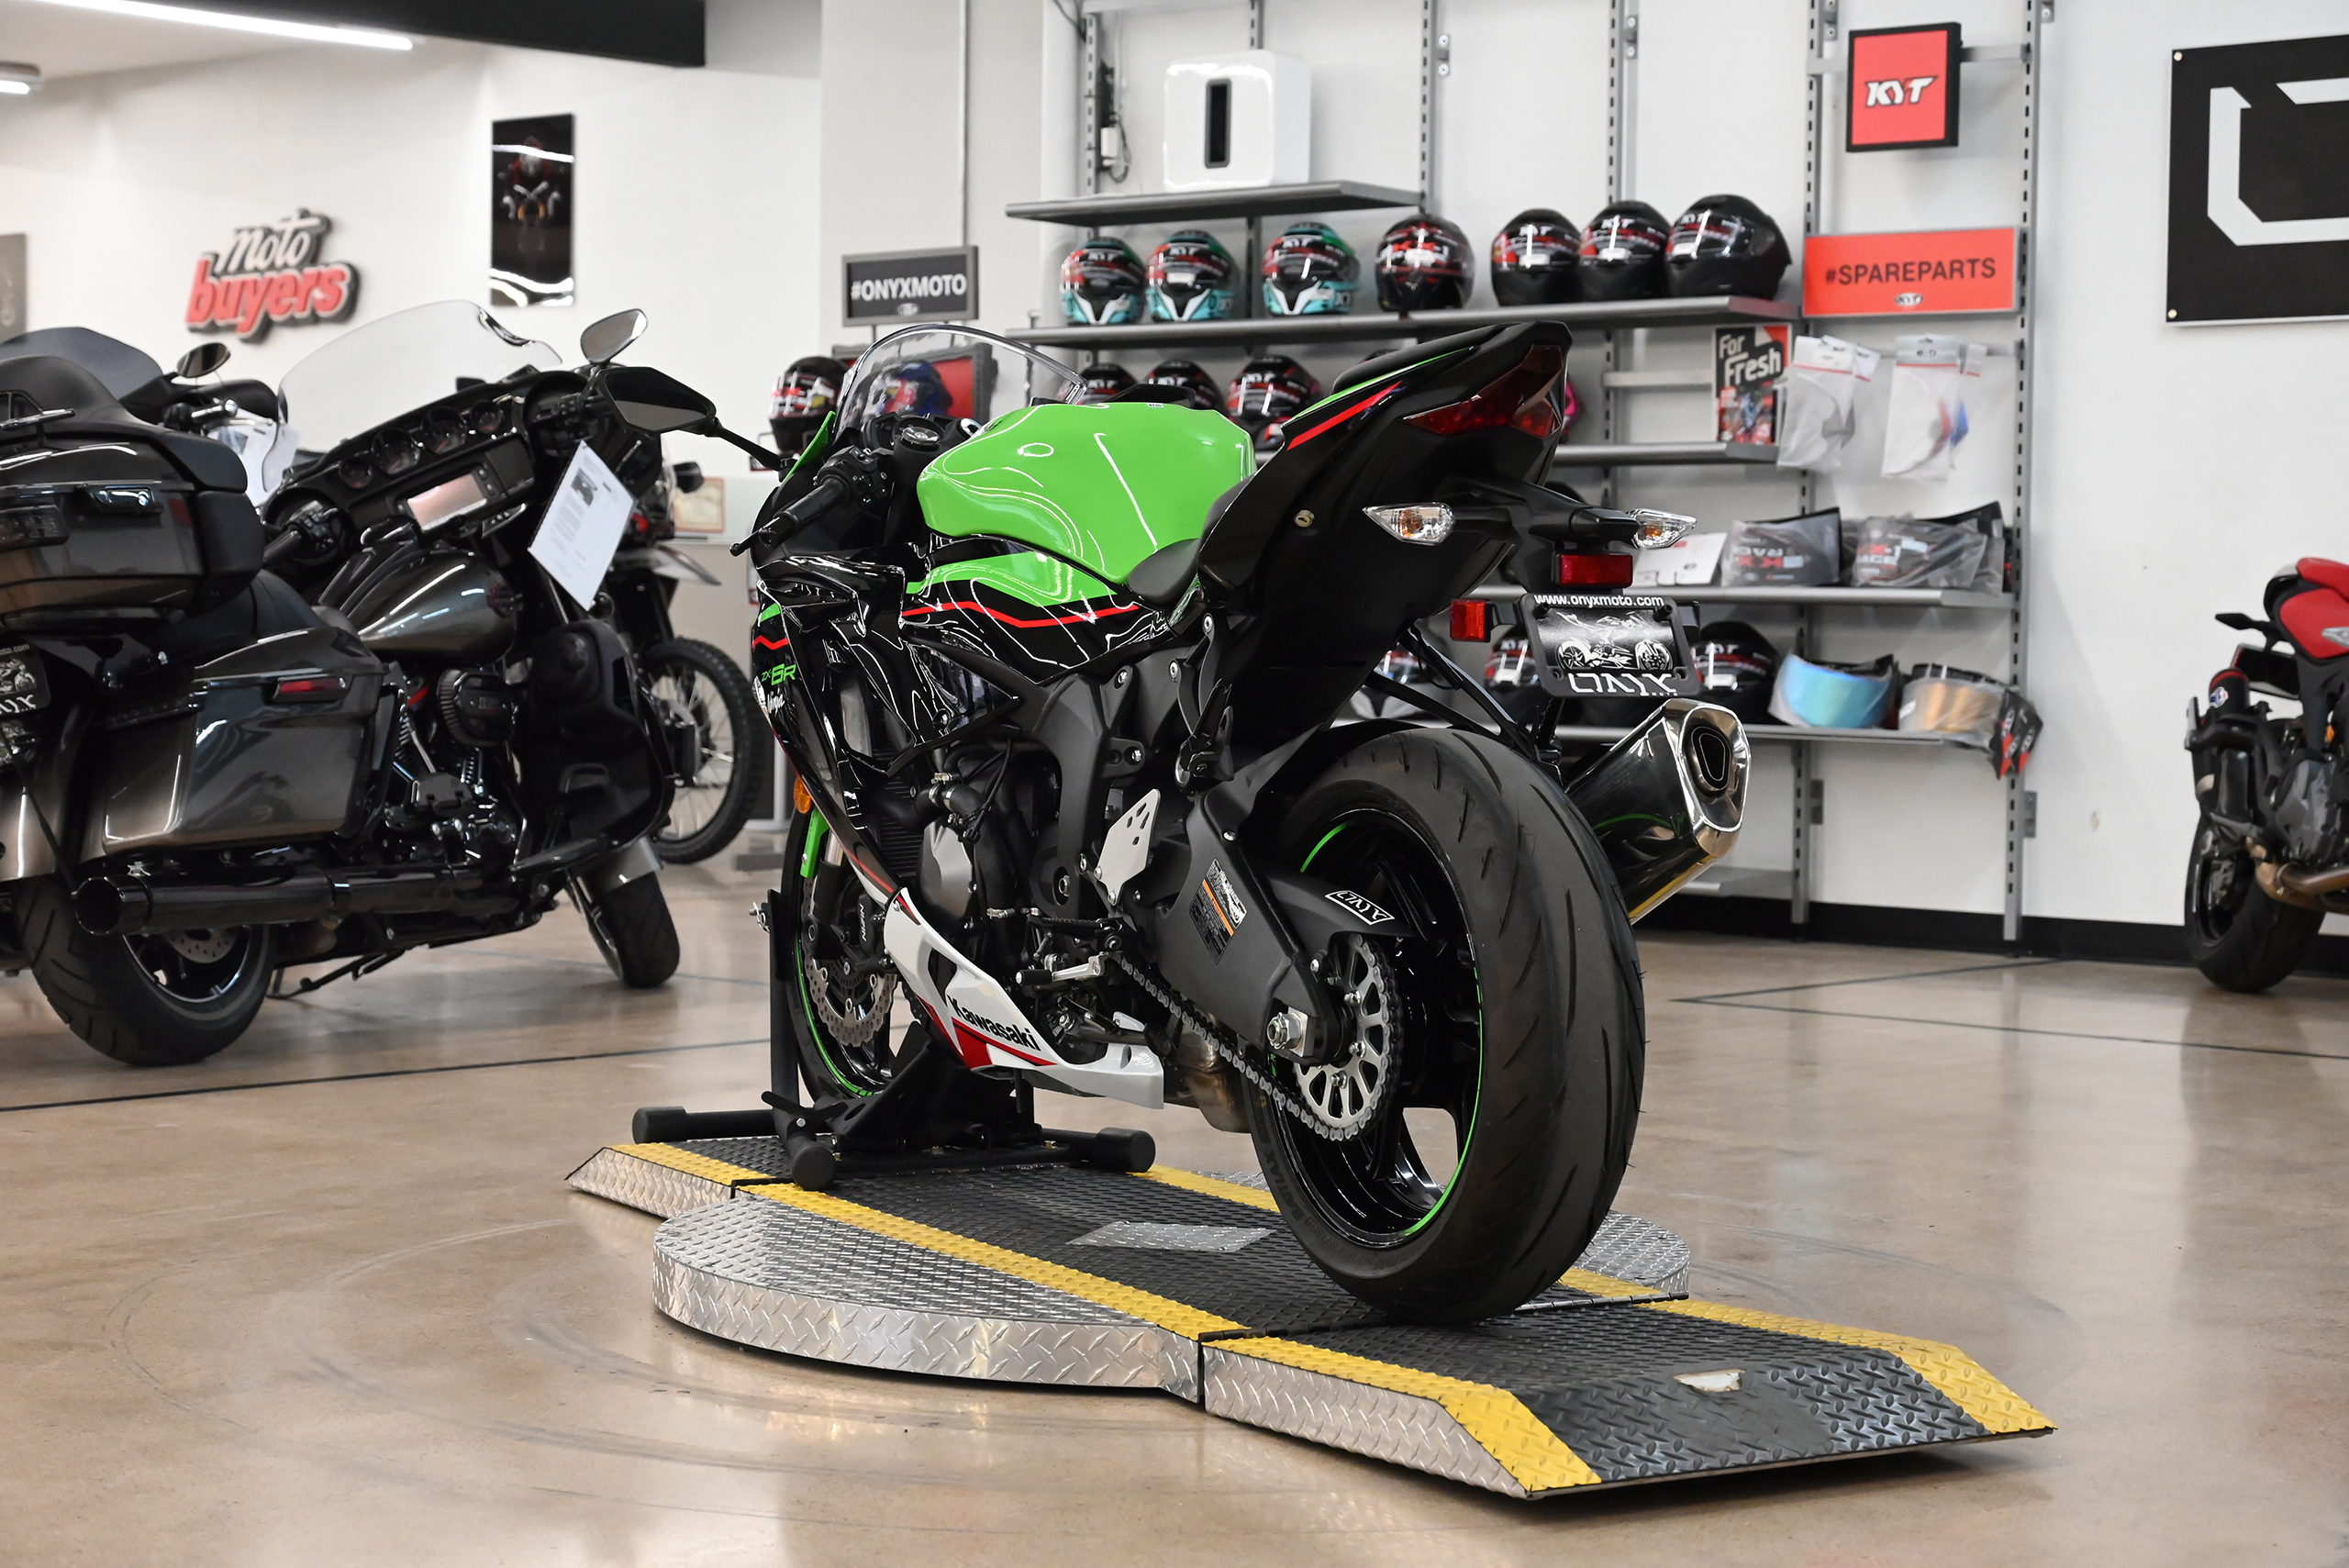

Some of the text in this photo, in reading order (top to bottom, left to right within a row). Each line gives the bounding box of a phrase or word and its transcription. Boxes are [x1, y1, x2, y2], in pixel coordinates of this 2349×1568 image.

[1865, 75, 1939, 107] KYT
[1825, 257, 1997, 286] #SPAREPARTS
[185, 258, 348, 334] buyers
[851, 273, 967, 301] #ONYXMOTO
[1719, 334, 1745, 359] For
[1724, 347, 1780, 387] Fresh
[1534, 595, 1664, 608] www.onyxmoto.com
[762, 663, 796, 685] ZX-6R
[1567, 673, 1677, 696] ONYX
[946, 994, 1041, 1052] Kawasaki
